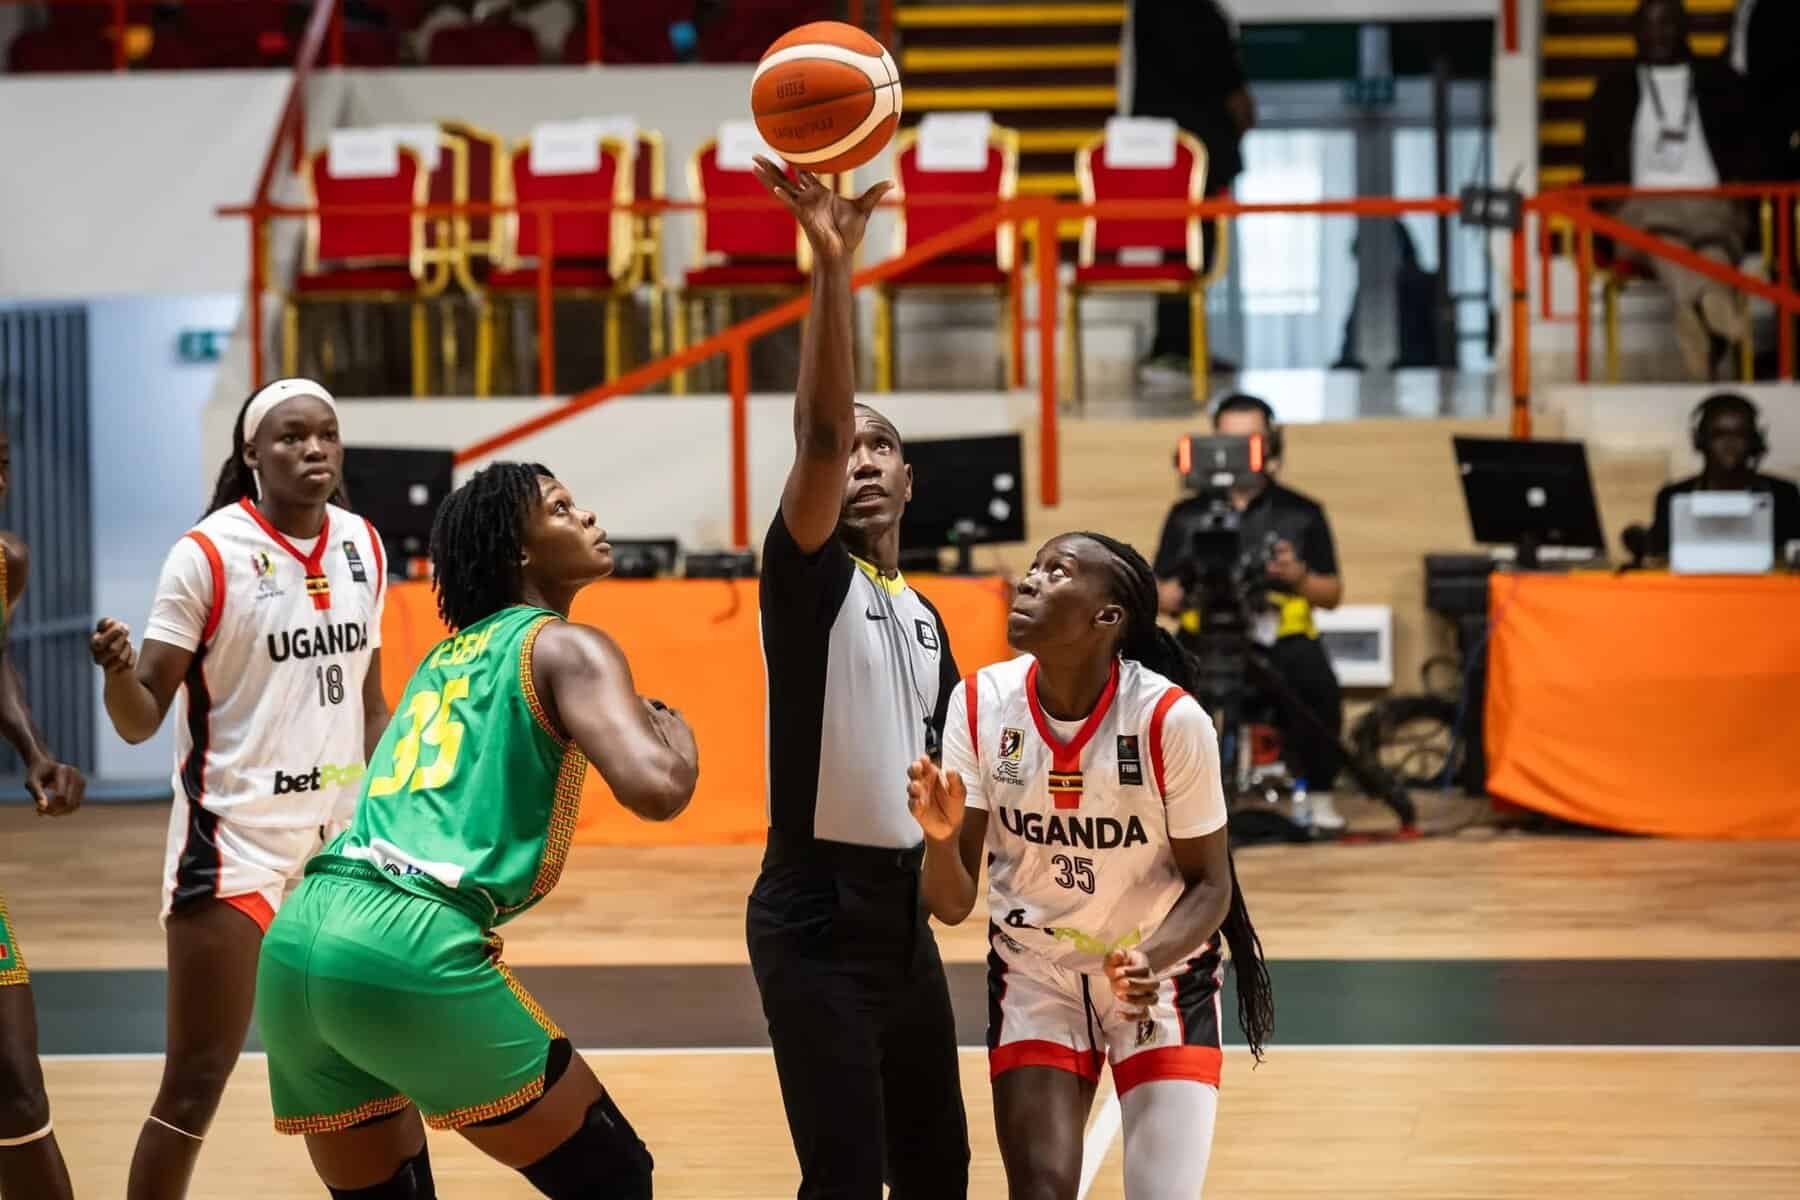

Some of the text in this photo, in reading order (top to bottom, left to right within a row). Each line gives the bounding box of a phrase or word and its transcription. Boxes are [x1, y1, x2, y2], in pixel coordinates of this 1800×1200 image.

[267, 622, 368, 662] UGANDA
[316, 664, 345, 707] 18
[368, 674, 470, 798] 35
[999, 806, 1149, 849] UGANDA
[1052, 854, 1096, 895] 35
